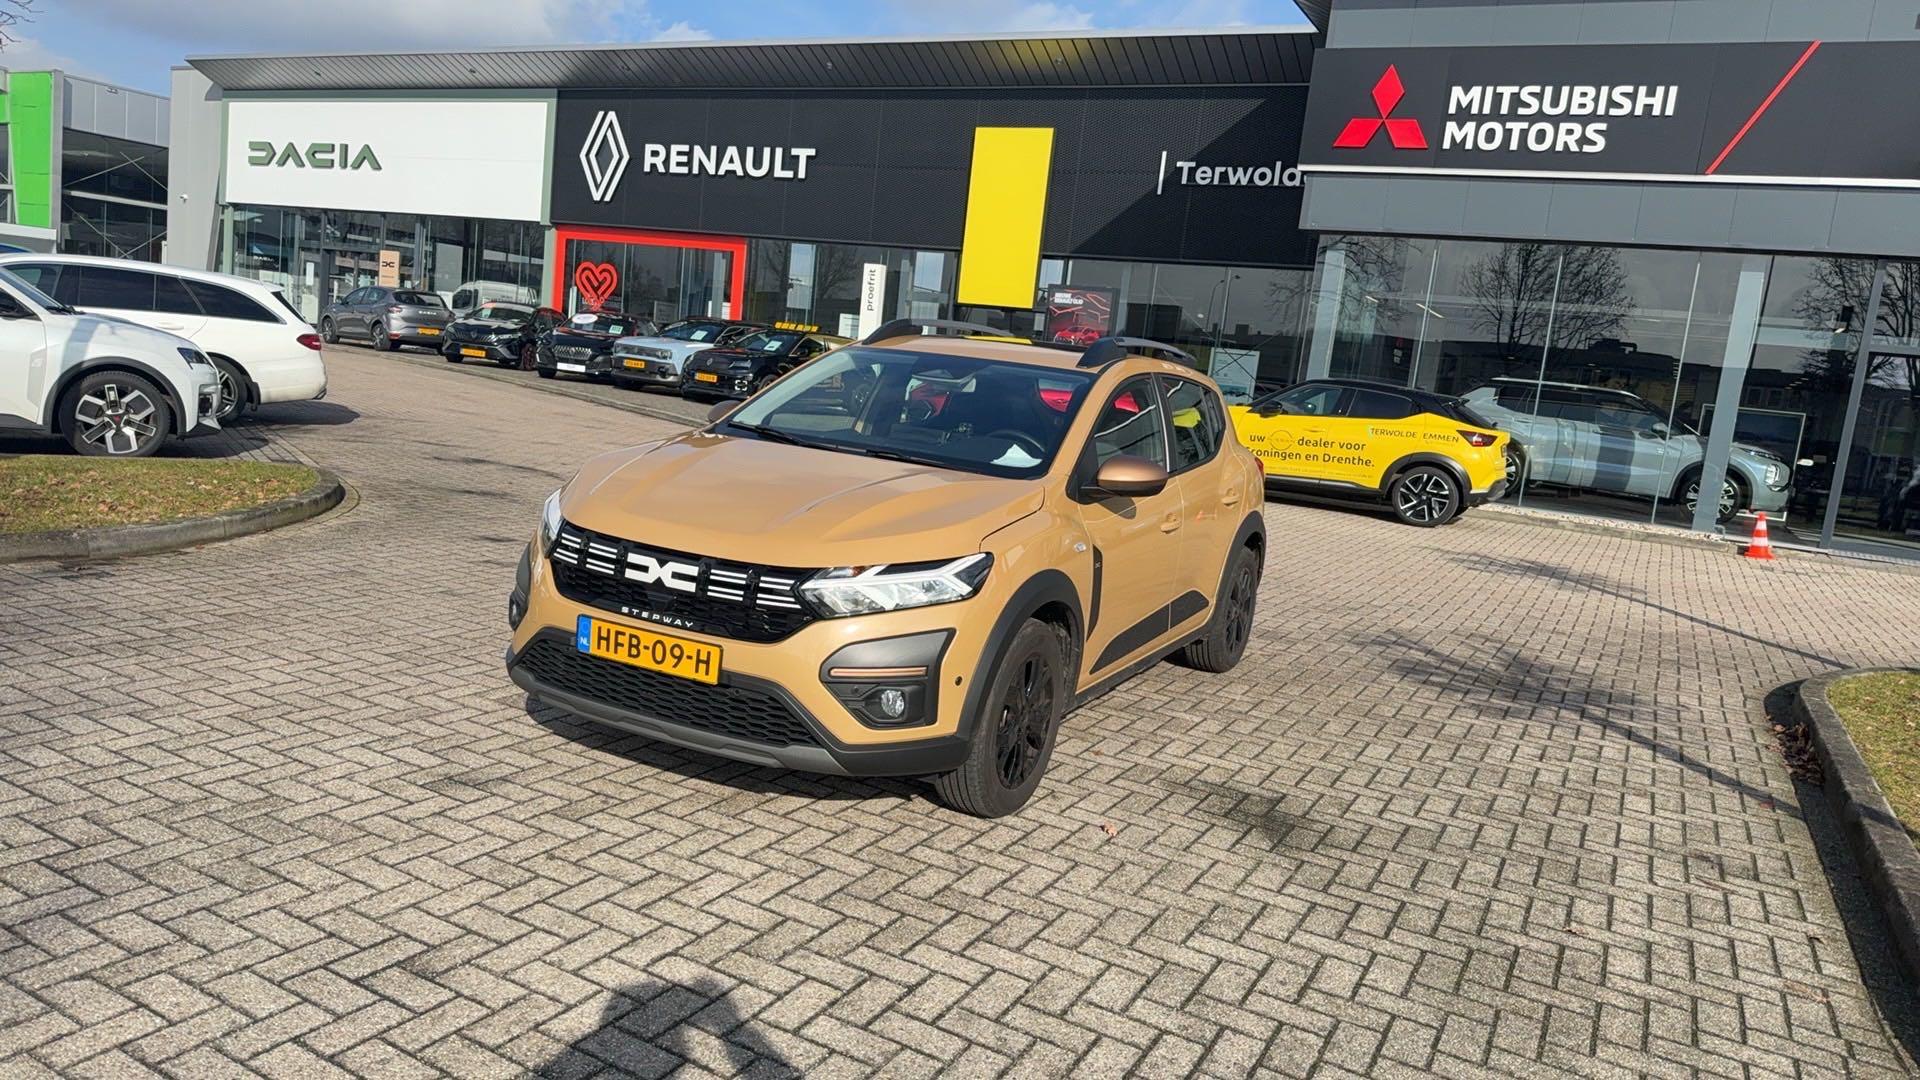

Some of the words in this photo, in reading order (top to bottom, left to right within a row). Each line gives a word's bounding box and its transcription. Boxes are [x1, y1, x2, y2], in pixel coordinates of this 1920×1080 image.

[1447, 85, 1678, 116] MITSUBISHI
[1442, 121, 1608, 153] MOTORS
[248, 141, 383, 171] DACIA
[643, 143, 816, 179] RENAULT
[867, 268, 877, 312] proefrit
[1249, 433, 1266, 443] uw
[1297, 436, 1336, 449] dealer
[1338, 441, 1367, 452] voor
[1371, 428, 1417, 439] TERWOLDE
[1422, 432, 1460, 443] EMMEN
[1247, 447, 1302, 461] roningen
[1304, 453, 1319, 463] en
[1322, 453, 1376, 468] Drenthe.
[621, 606, 694, 628] STEPWAY
[597, 625, 711, 676] HFB-09-H
